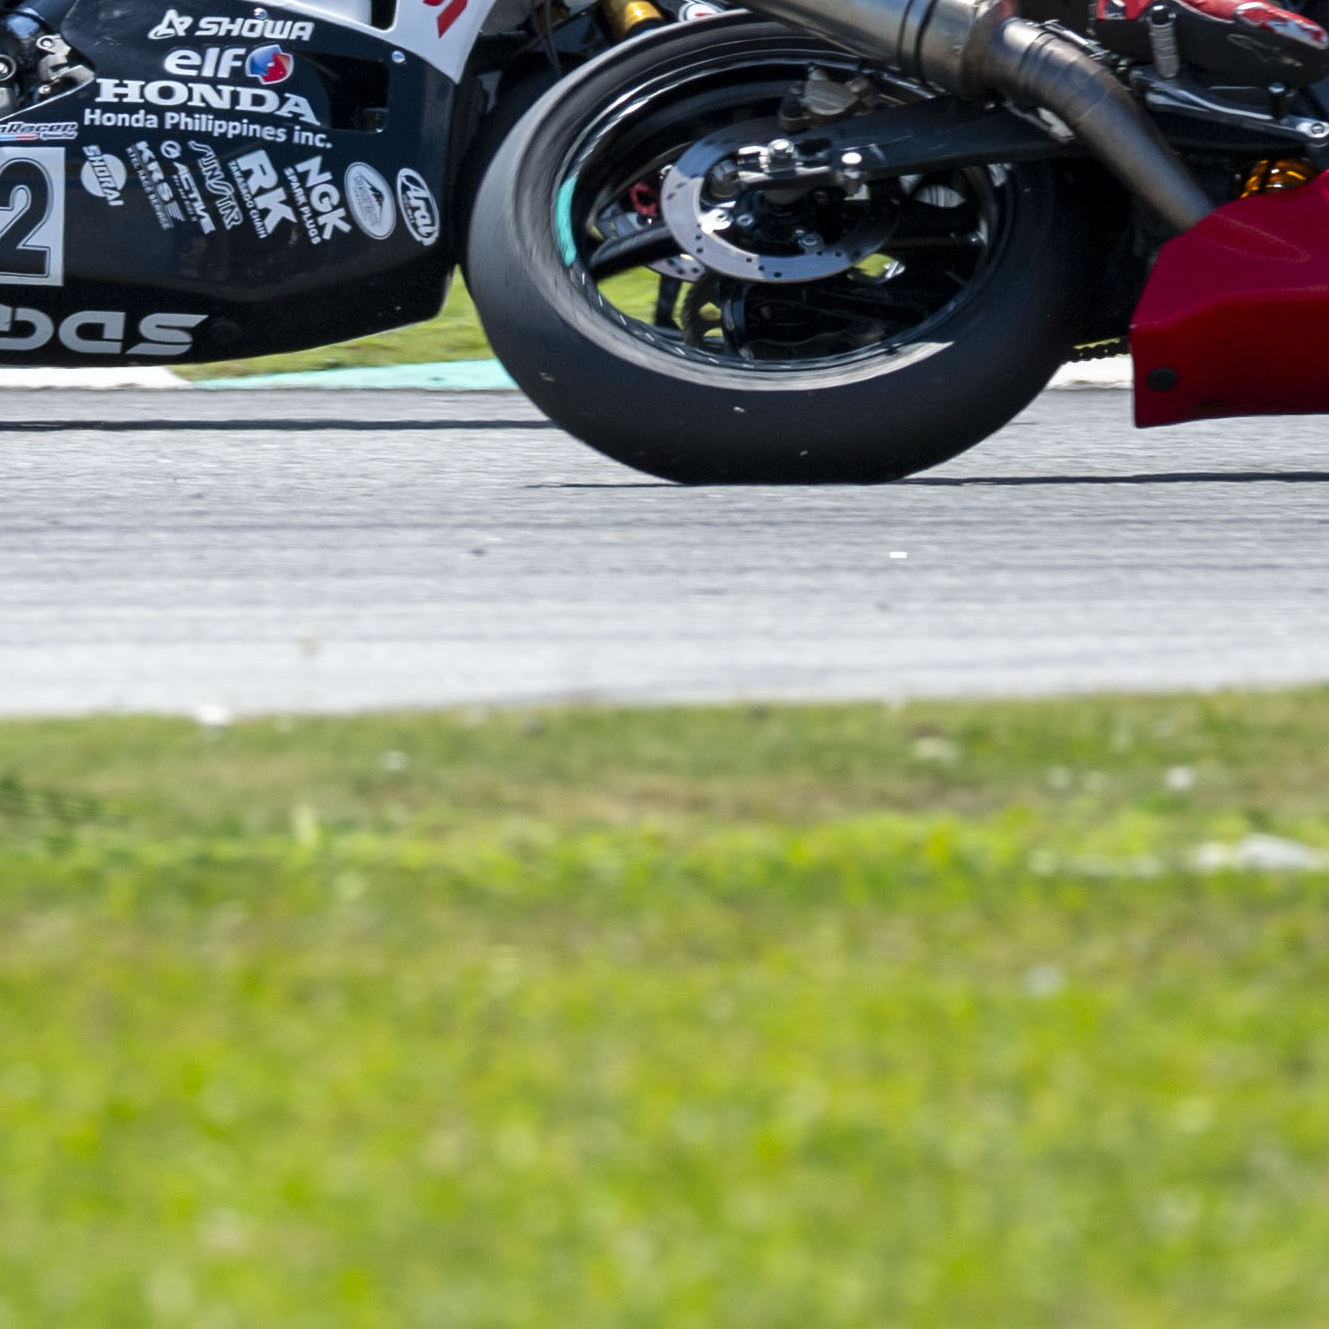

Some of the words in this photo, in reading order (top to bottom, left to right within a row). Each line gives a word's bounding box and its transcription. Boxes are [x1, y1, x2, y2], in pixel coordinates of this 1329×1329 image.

[194, 15, 316, 42] SHOWA
[164, 46, 248, 78] elf
[84, 108, 159, 129] Honda
[163, 111, 288, 142] Philippines
[292, 128, 333, 149] inc.
[94, 78, 322, 126] HONDA
[82, 144, 125, 207] SHORAI
[135, 140, 174, 202] KRS
[172, 161, 216, 235] ACTIVE
[187, 139, 244, 231] SUNSTAR
[227, 160, 256, 208] TAKASAGO
[248, 207, 269, 239] CHAIN
[236, 149, 298, 235] RK
[294, 155, 352, 241] NGK
[283, 167, 304, 207] SPARK
[299, 204, 322, 246] PLUGS
[401, 173, 438, 239] Arai
